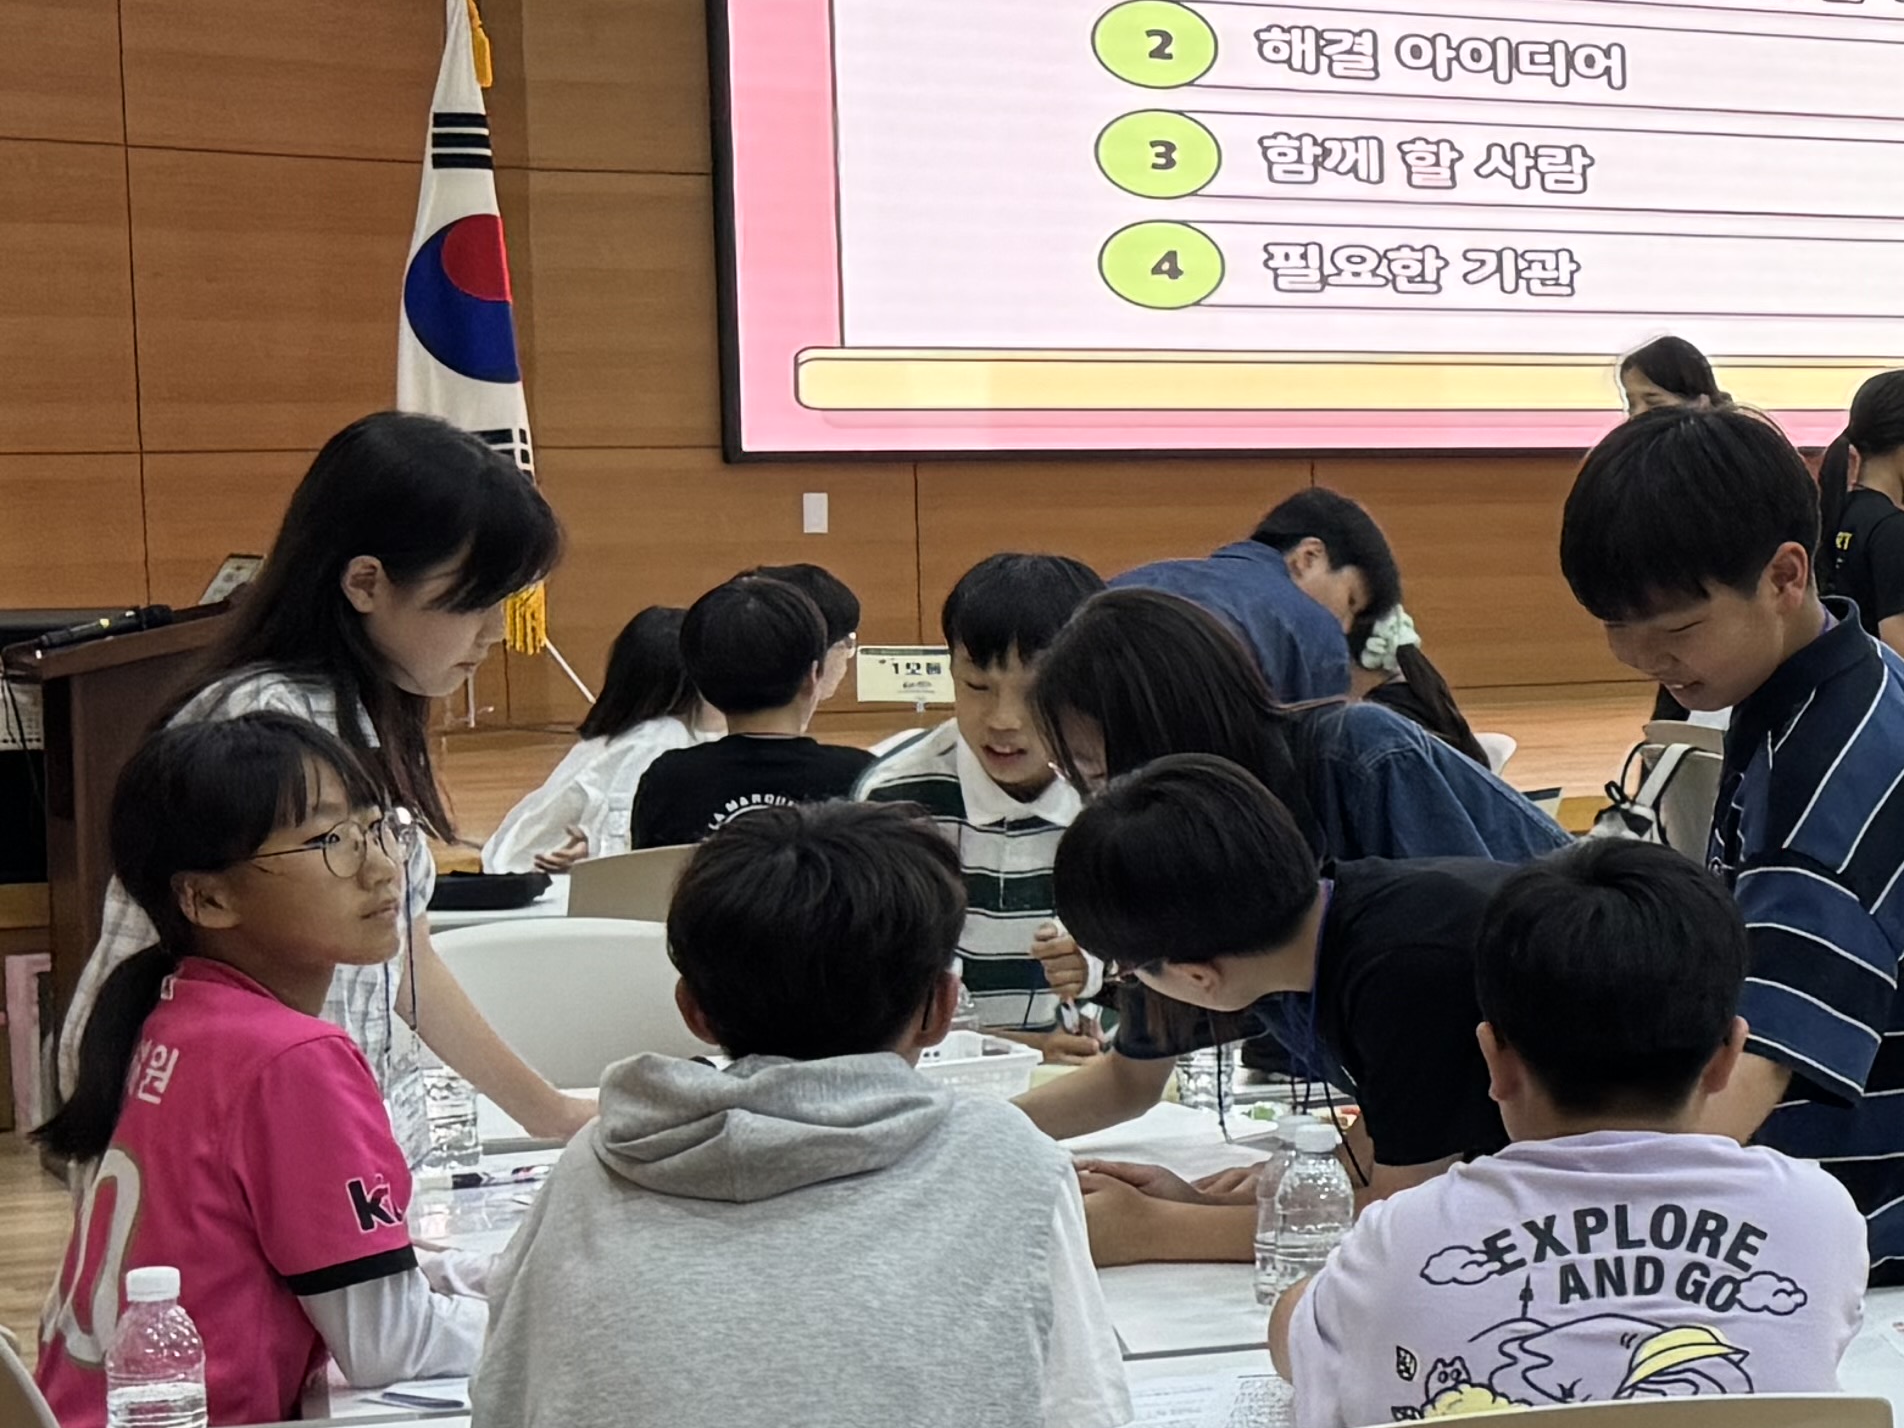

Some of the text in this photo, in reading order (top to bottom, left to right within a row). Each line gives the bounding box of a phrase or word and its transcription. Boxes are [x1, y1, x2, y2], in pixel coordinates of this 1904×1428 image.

[1146, 24, 1627, 91] 2 해결 아이디어
[1149, 132, 1595, 195] 3 함께 할 사람
[1151, 241, 1582, 298] 4 필요한 기관
[1482, 1203, 1767, 1275] EXPLORE
[1559, 1255, 1740, 1313] AND GO
